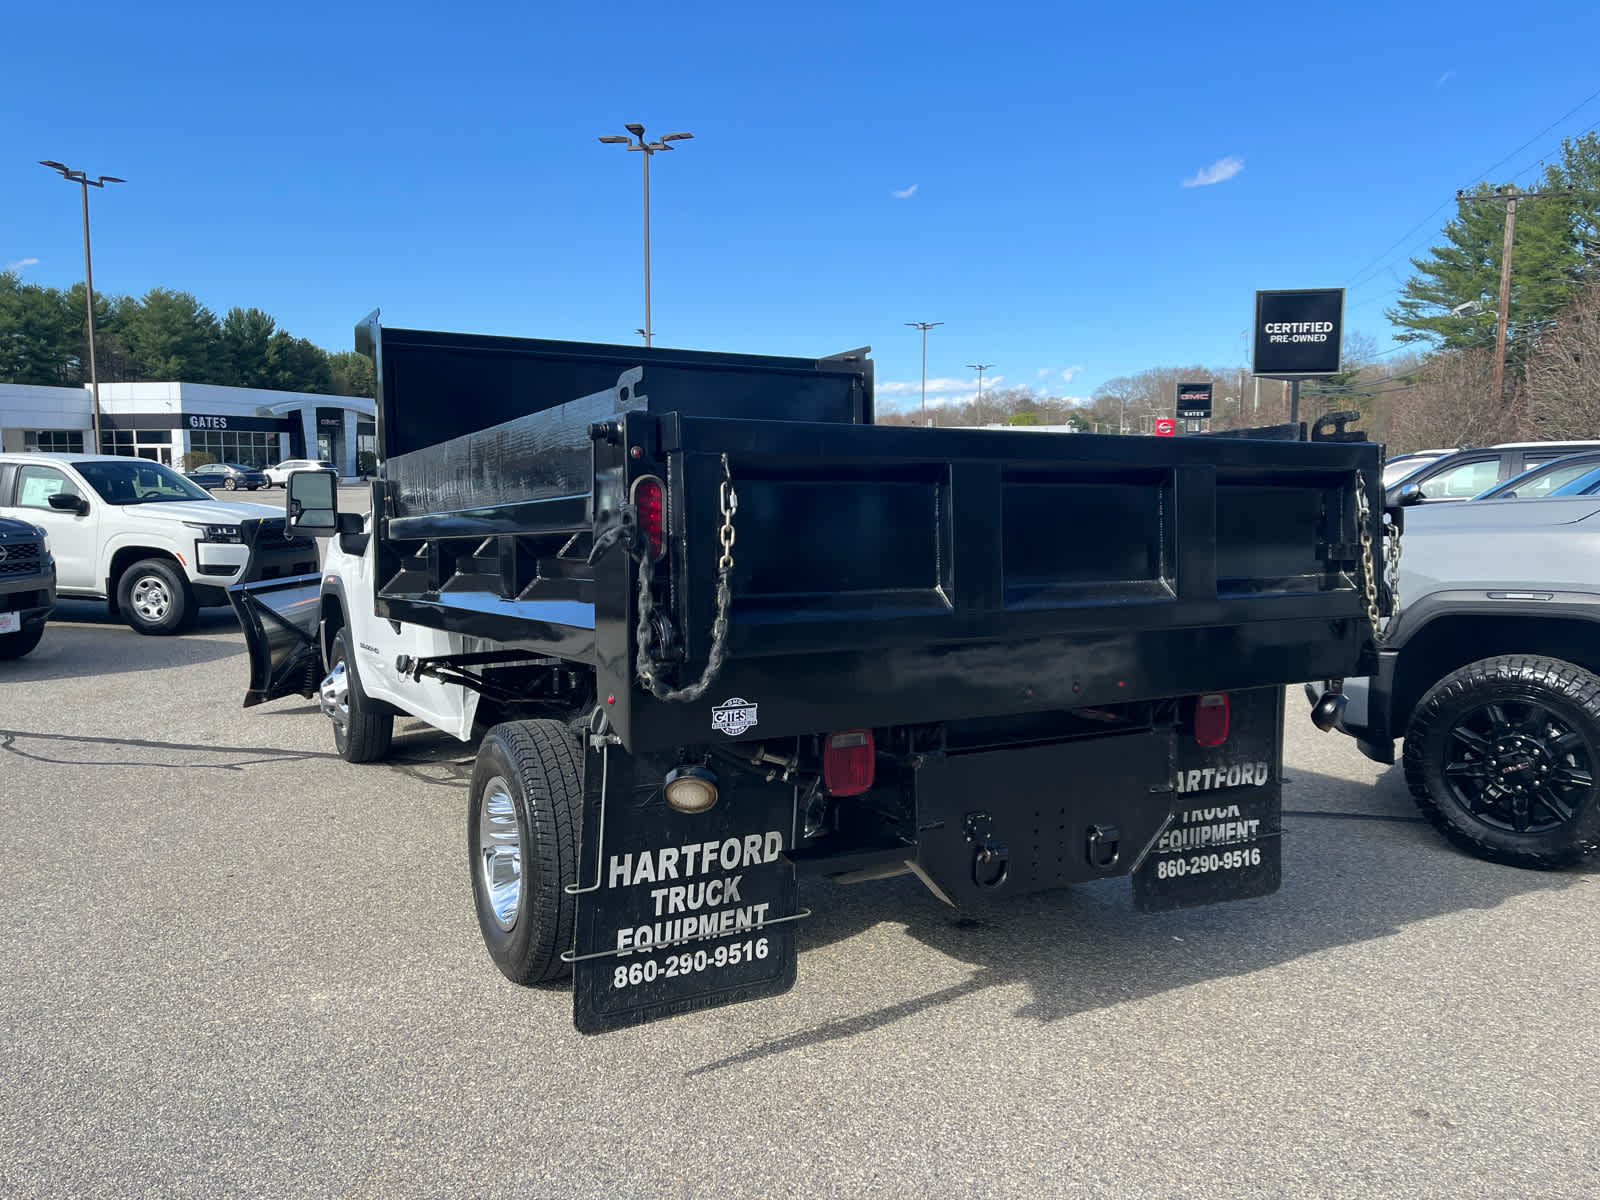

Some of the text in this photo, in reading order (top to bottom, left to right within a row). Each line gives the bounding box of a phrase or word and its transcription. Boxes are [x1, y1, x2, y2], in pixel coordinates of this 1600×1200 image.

[1265, 321, 1334, 334] CERTIFIED
[1270, 334, 1328, 343] PRE-OWNED
[189, 415, 227, 429] GATES
[714, 710, 746, 723] GATES
[1159, 819, 1261, 854] EQUIPMENT
[608, 831, 783, 889] HARTFORD
[1158, 847, 1261, 880] 860-290-9516
[651, 875, 743, 917] TRUCK
[616, 903, 769, 957] EQUIPMENT
[613, 937, 769, 989] 860-290-9516
